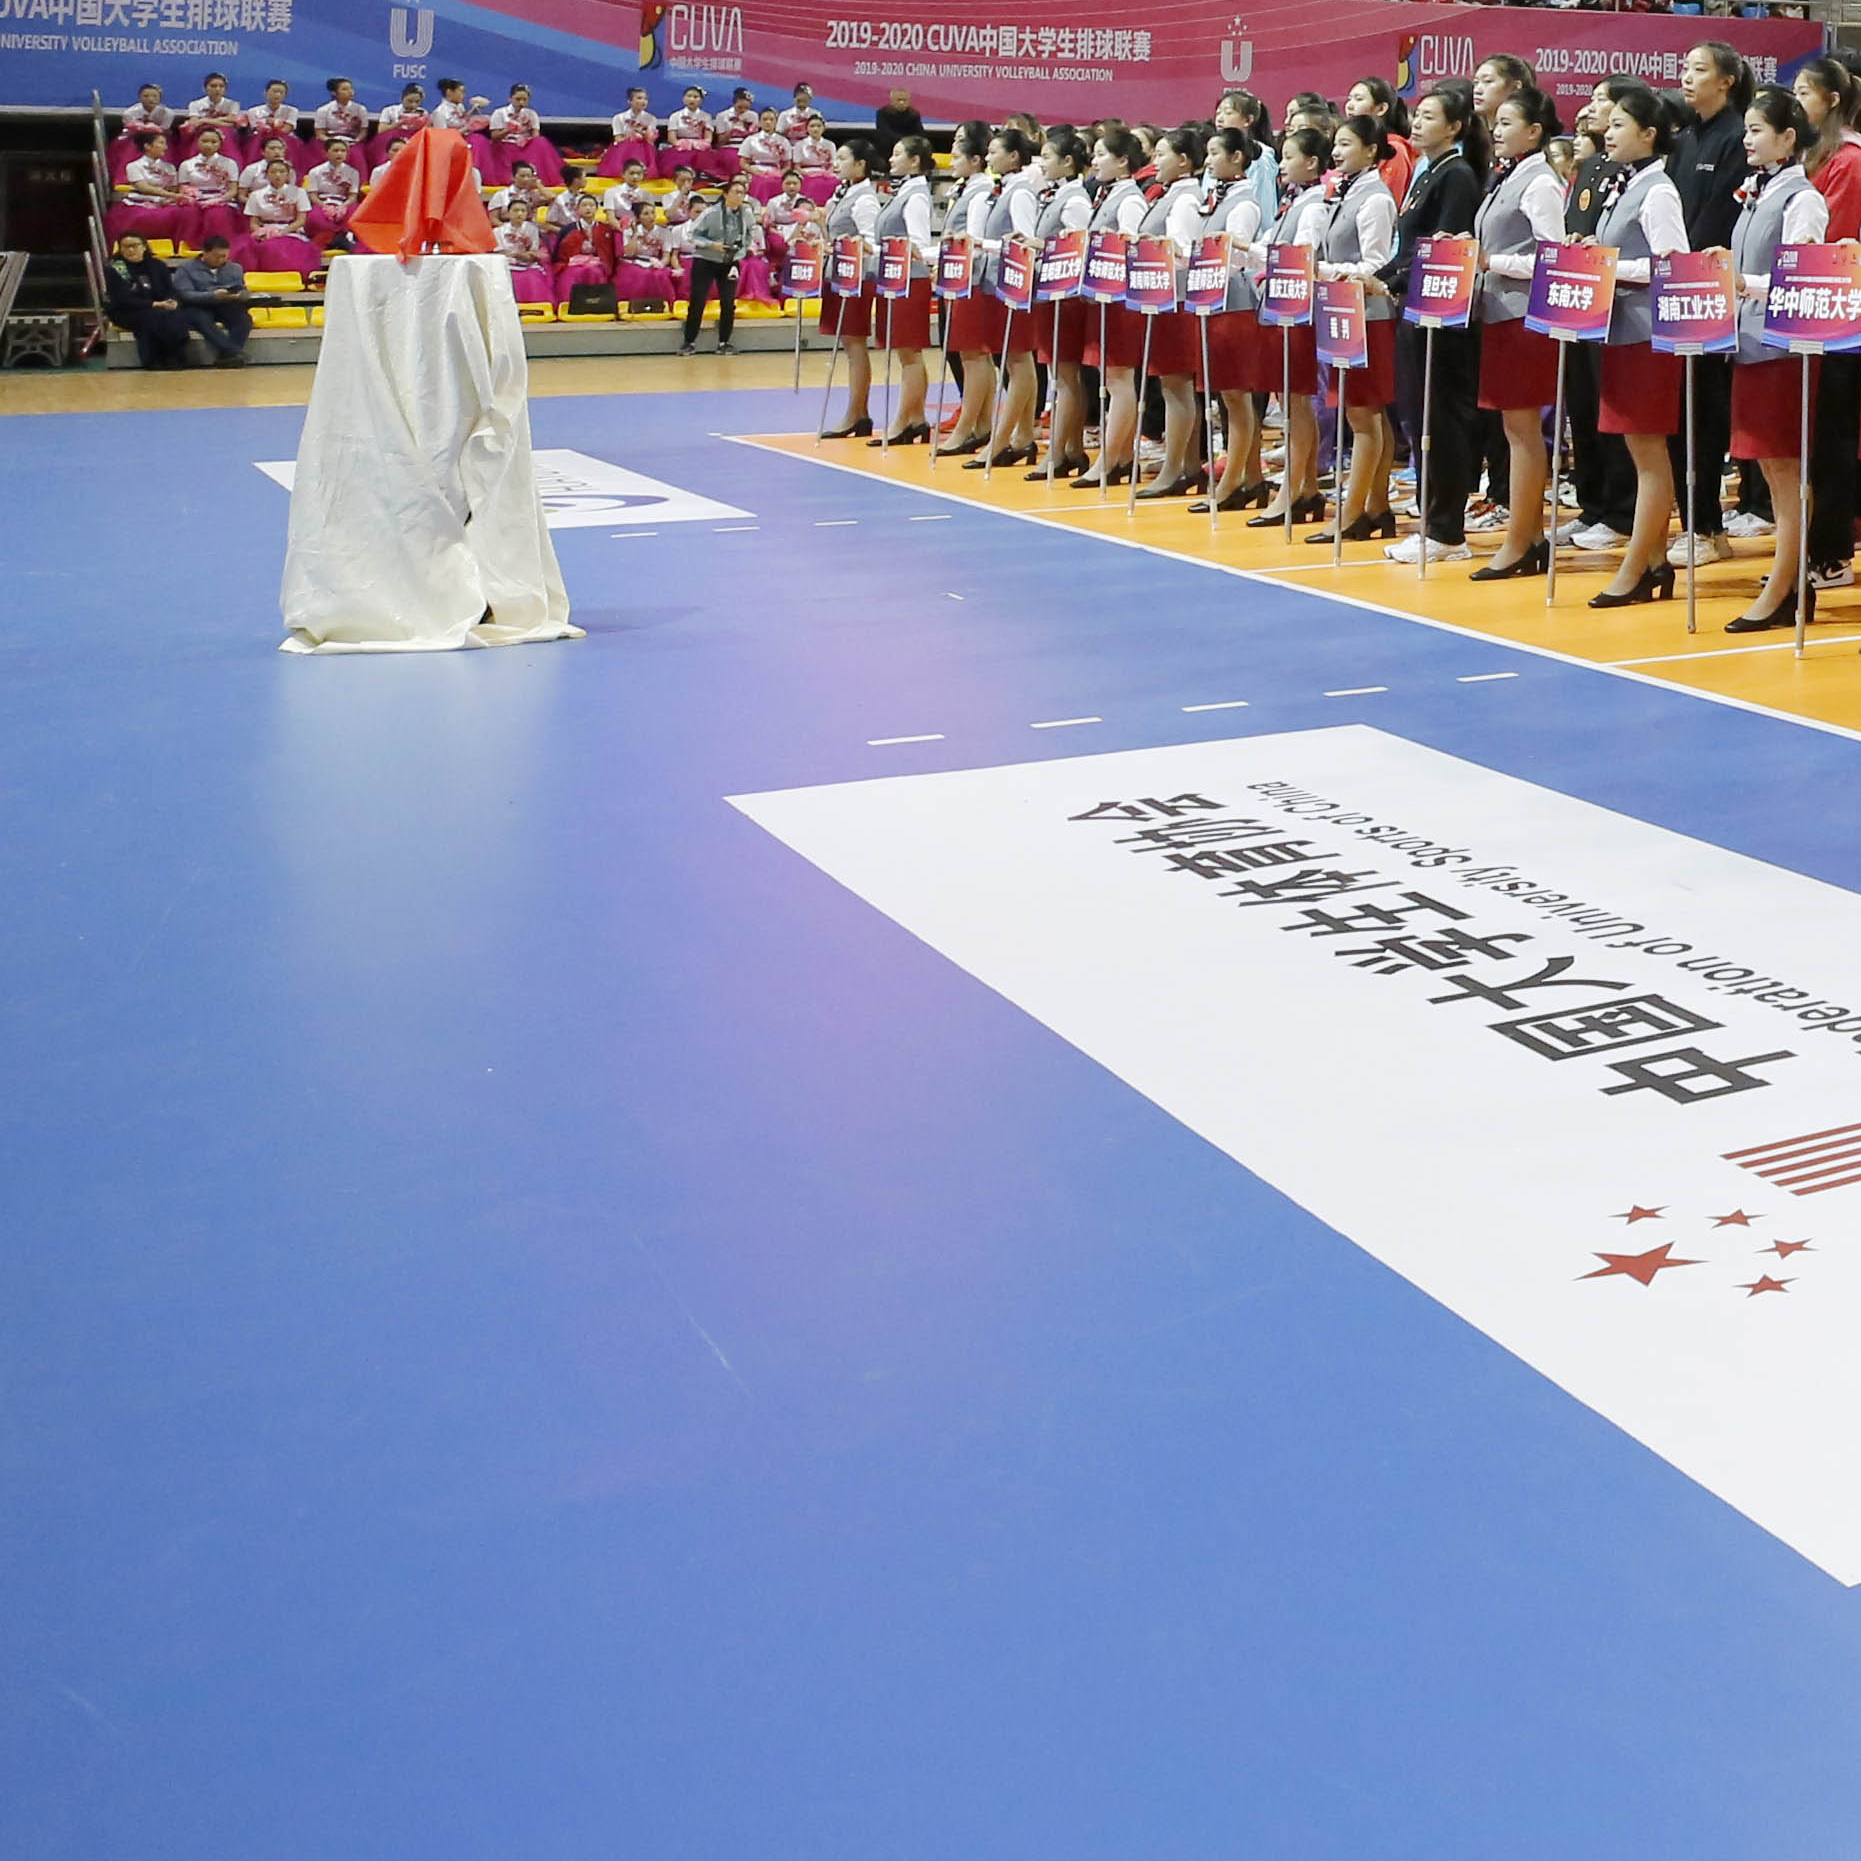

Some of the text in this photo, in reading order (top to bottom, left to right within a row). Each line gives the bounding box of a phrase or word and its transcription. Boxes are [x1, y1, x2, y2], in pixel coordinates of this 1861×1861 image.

[670, 4, 743, 52] CUVA
[826, 20, 1152, 62] 2019-2020 CUVA中国大学生排球联赛
[72, 36, 150, 54] VOLLEYBALL
[153, 39, 238, 56] ASSOCIATION
[1420, 35, 1474, 75] CUVA
[393, 64, 427, 79] FUSC
[853, 61, 1113, 82] 2019-2020 CHINA UNIVERSITY VOLLEYBALL ASSOCIATION
[1535, 48, 1606, 74] 2019-2020
[1040, 258, 1081, 282] 昆明理工大学
[1421, 274, 1458, 300] 复旦大学
[1547, 282, 1594, 311] 东南大学
[1657, 294, 1727, 322] 湖南工业大学
[1247, 780, 1341, 816] China
[1303, 812, 1373, 827] of
[1355, 823, 1473, 869] Sports
[1450, 865, 1645, 940] University
[1067, 792, 1797, 1105] 中国大学生体育协会
[1605, 933, 1693, 957] of
